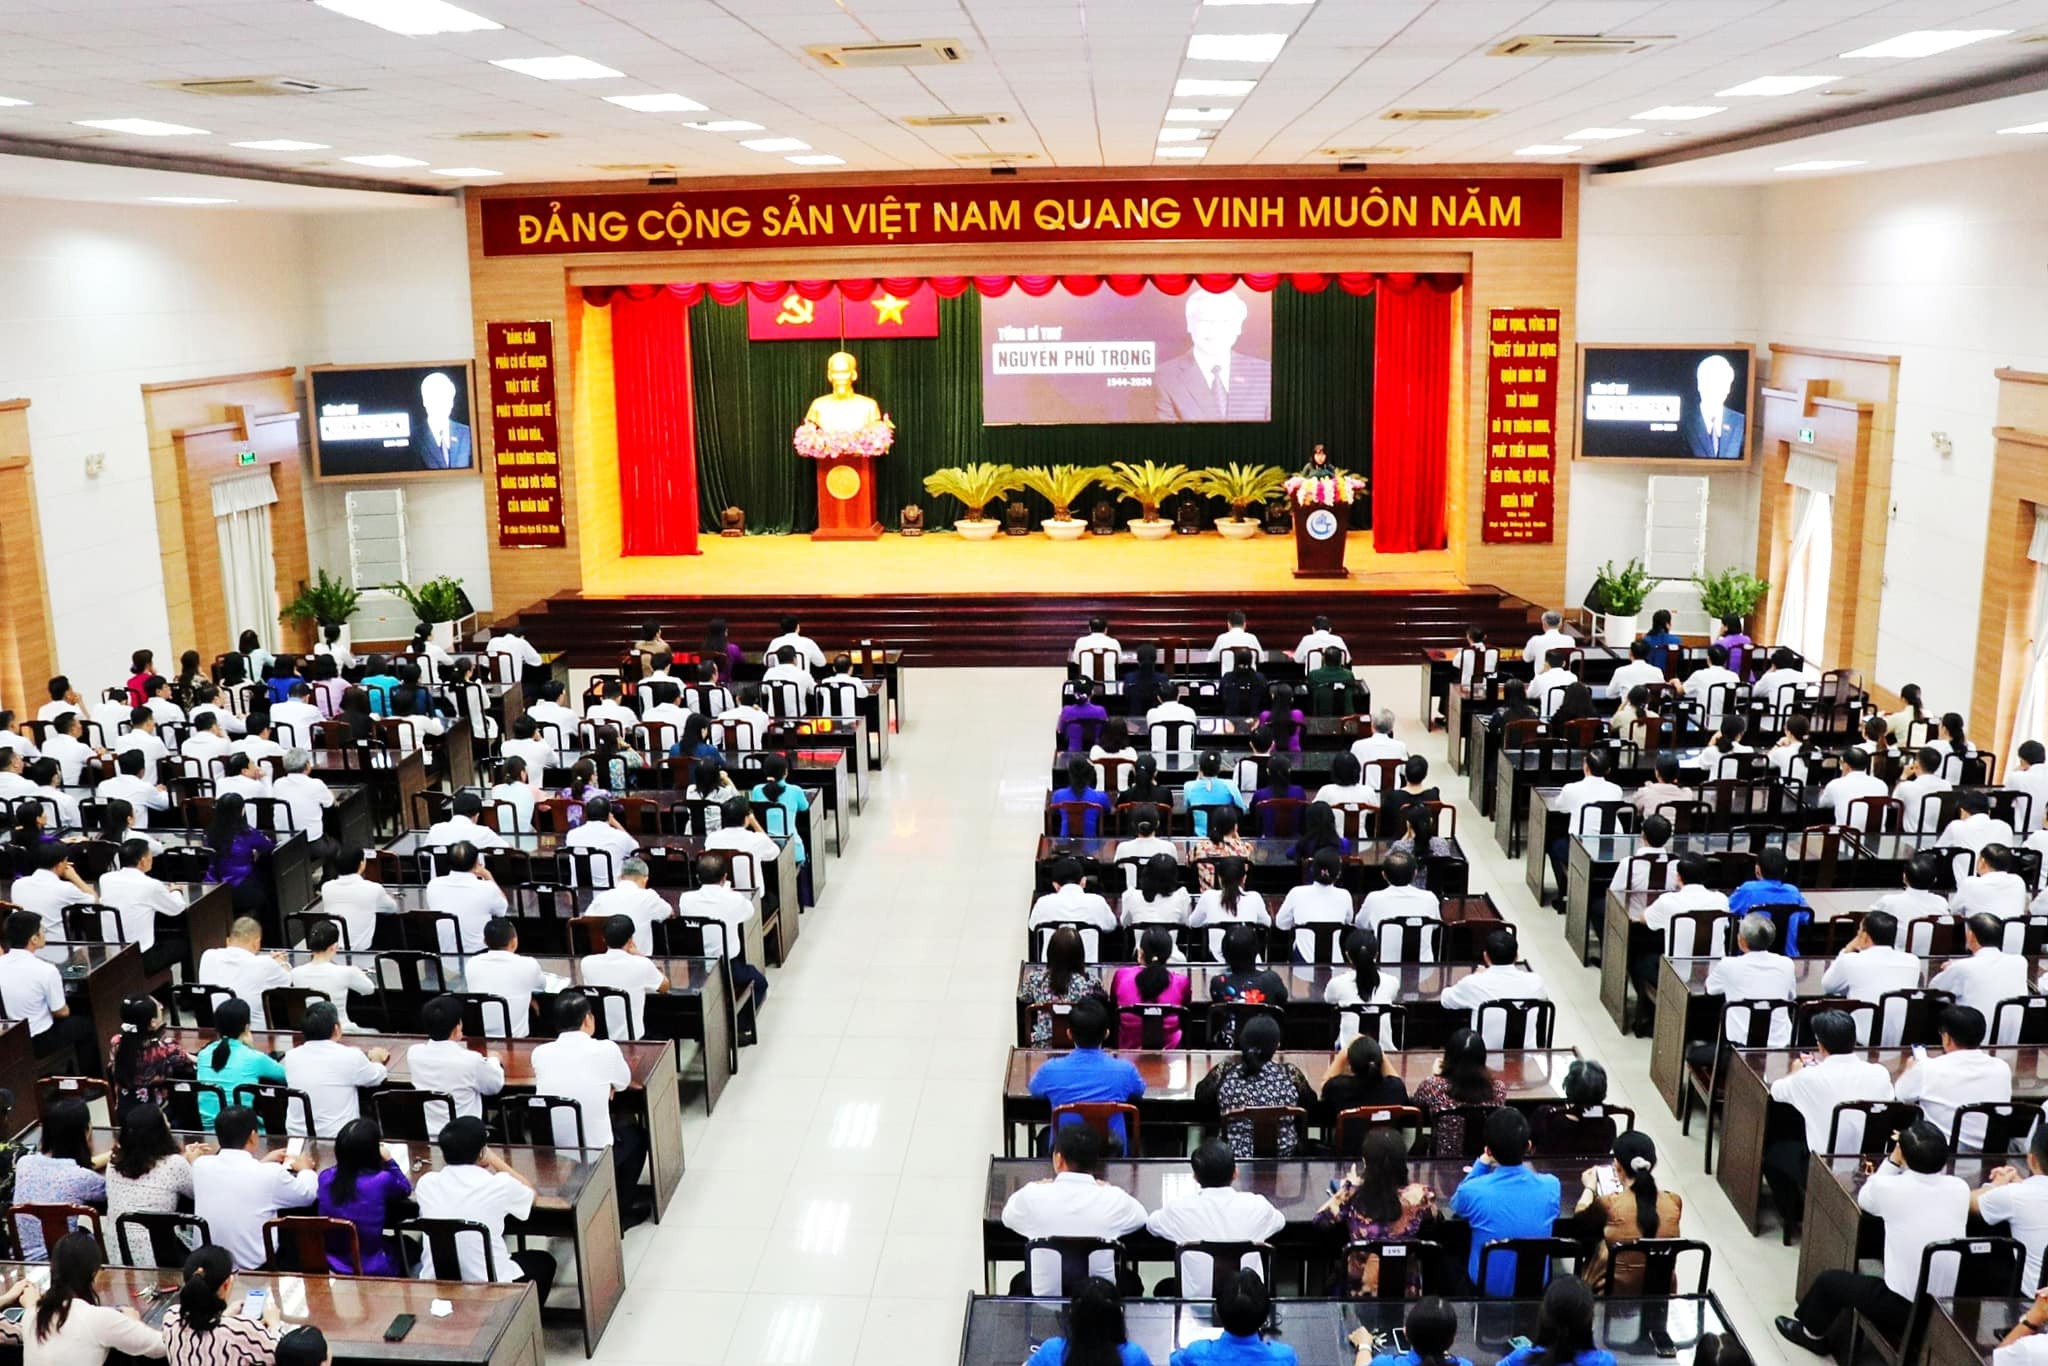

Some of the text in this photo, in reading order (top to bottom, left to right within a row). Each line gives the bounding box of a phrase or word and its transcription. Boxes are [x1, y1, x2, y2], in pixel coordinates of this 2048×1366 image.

[518, 186, 1522, 246] ĐẢNG CỘNG SẢN VIỆT NAM QUANG VINH MUÔN NĂM
[1065, 346, 1095, 366] PHÚ
[1101, 349, 1151, 370] TRỌNG
